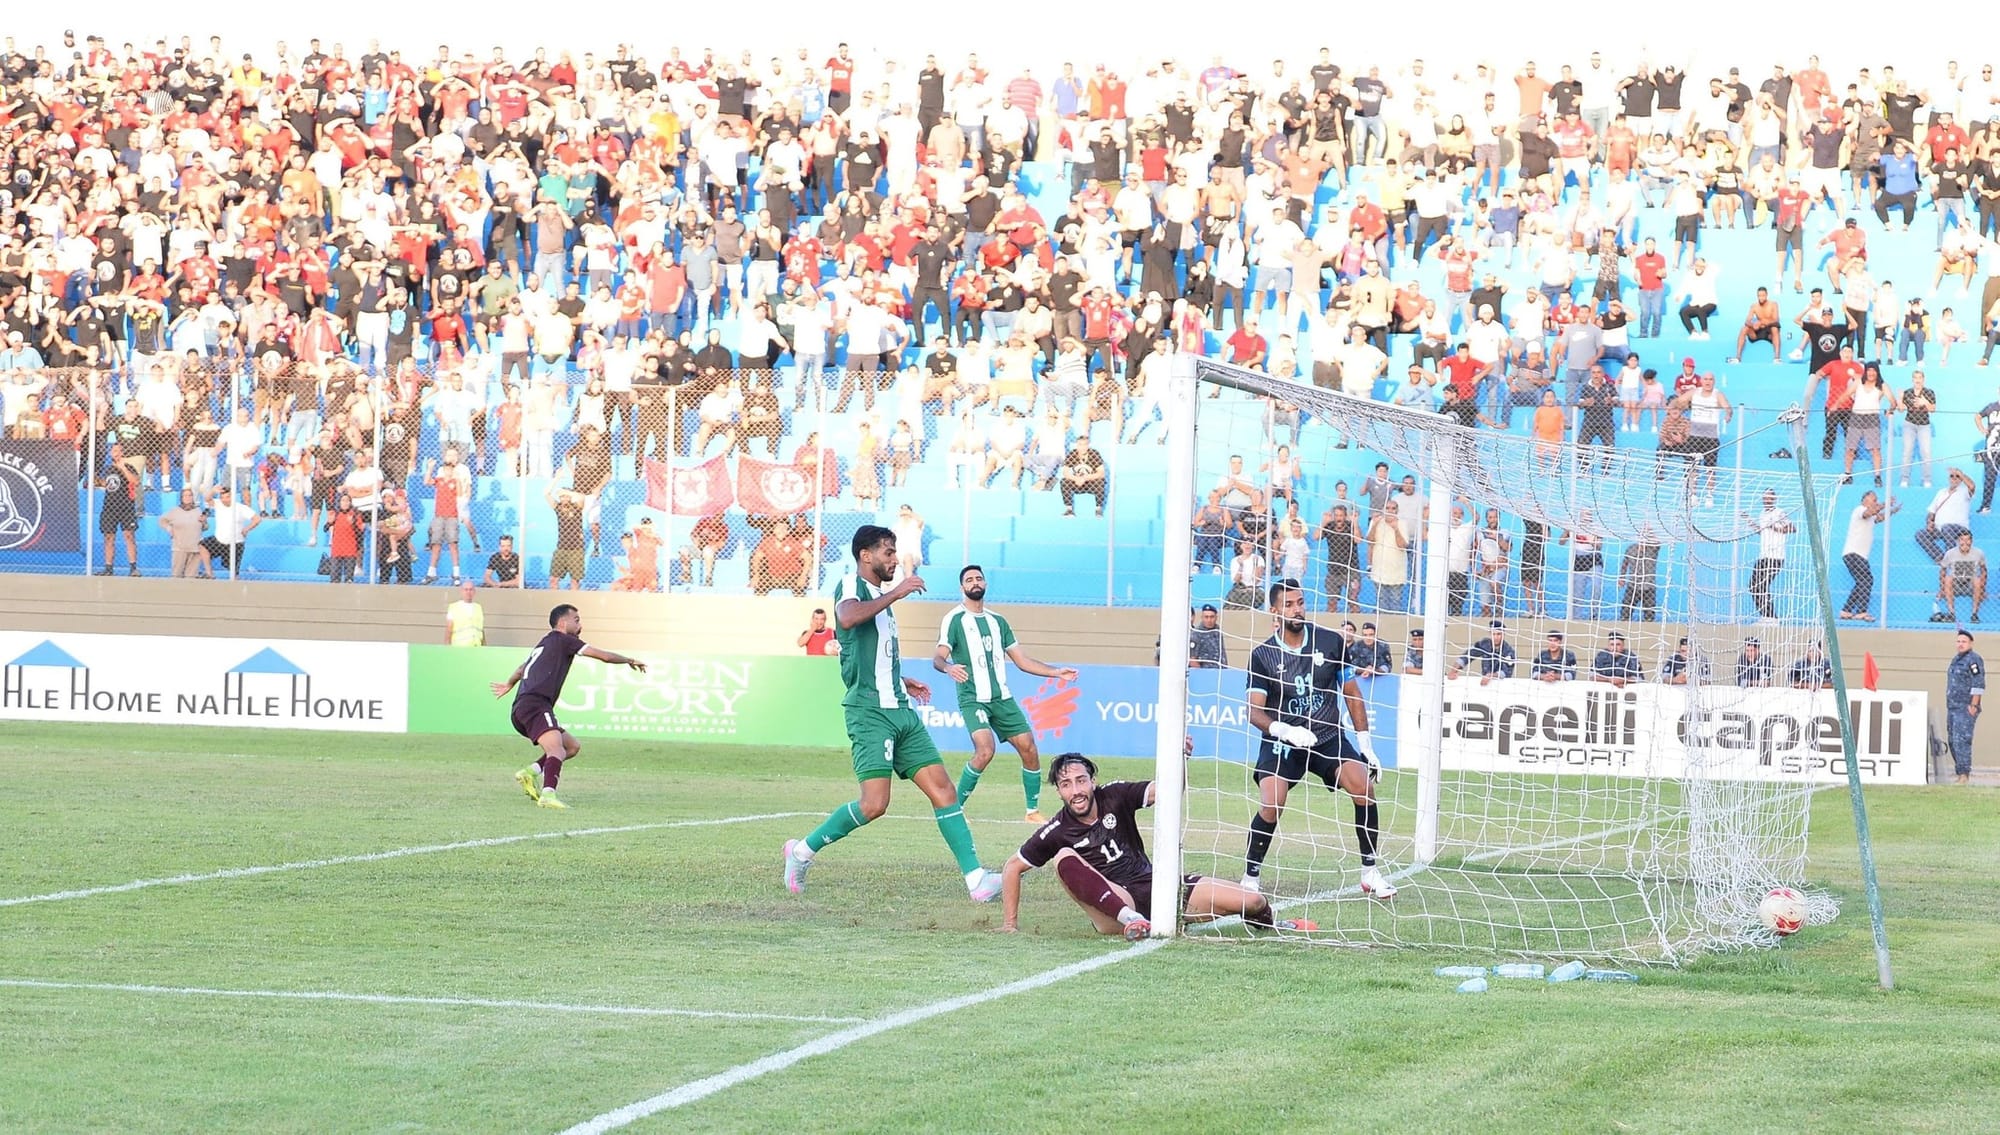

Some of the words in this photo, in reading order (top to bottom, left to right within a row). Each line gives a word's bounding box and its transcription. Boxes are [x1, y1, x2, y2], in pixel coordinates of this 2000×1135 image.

[71, 667, 162, 713] HOME
[177, 672, 280, 717] NAHLE
[291, 674, 384, 720] HOME
[1096, 700, 1159, 723] YOU
[1418, 691, 1637, 756] apelli
[1677, 700, 1903, 766] capelli
[1519, 745, 1635, 767] SPORT
[1781, 756, 1901, 777] SPORT
[1101, 838, 1124, 864] 11
